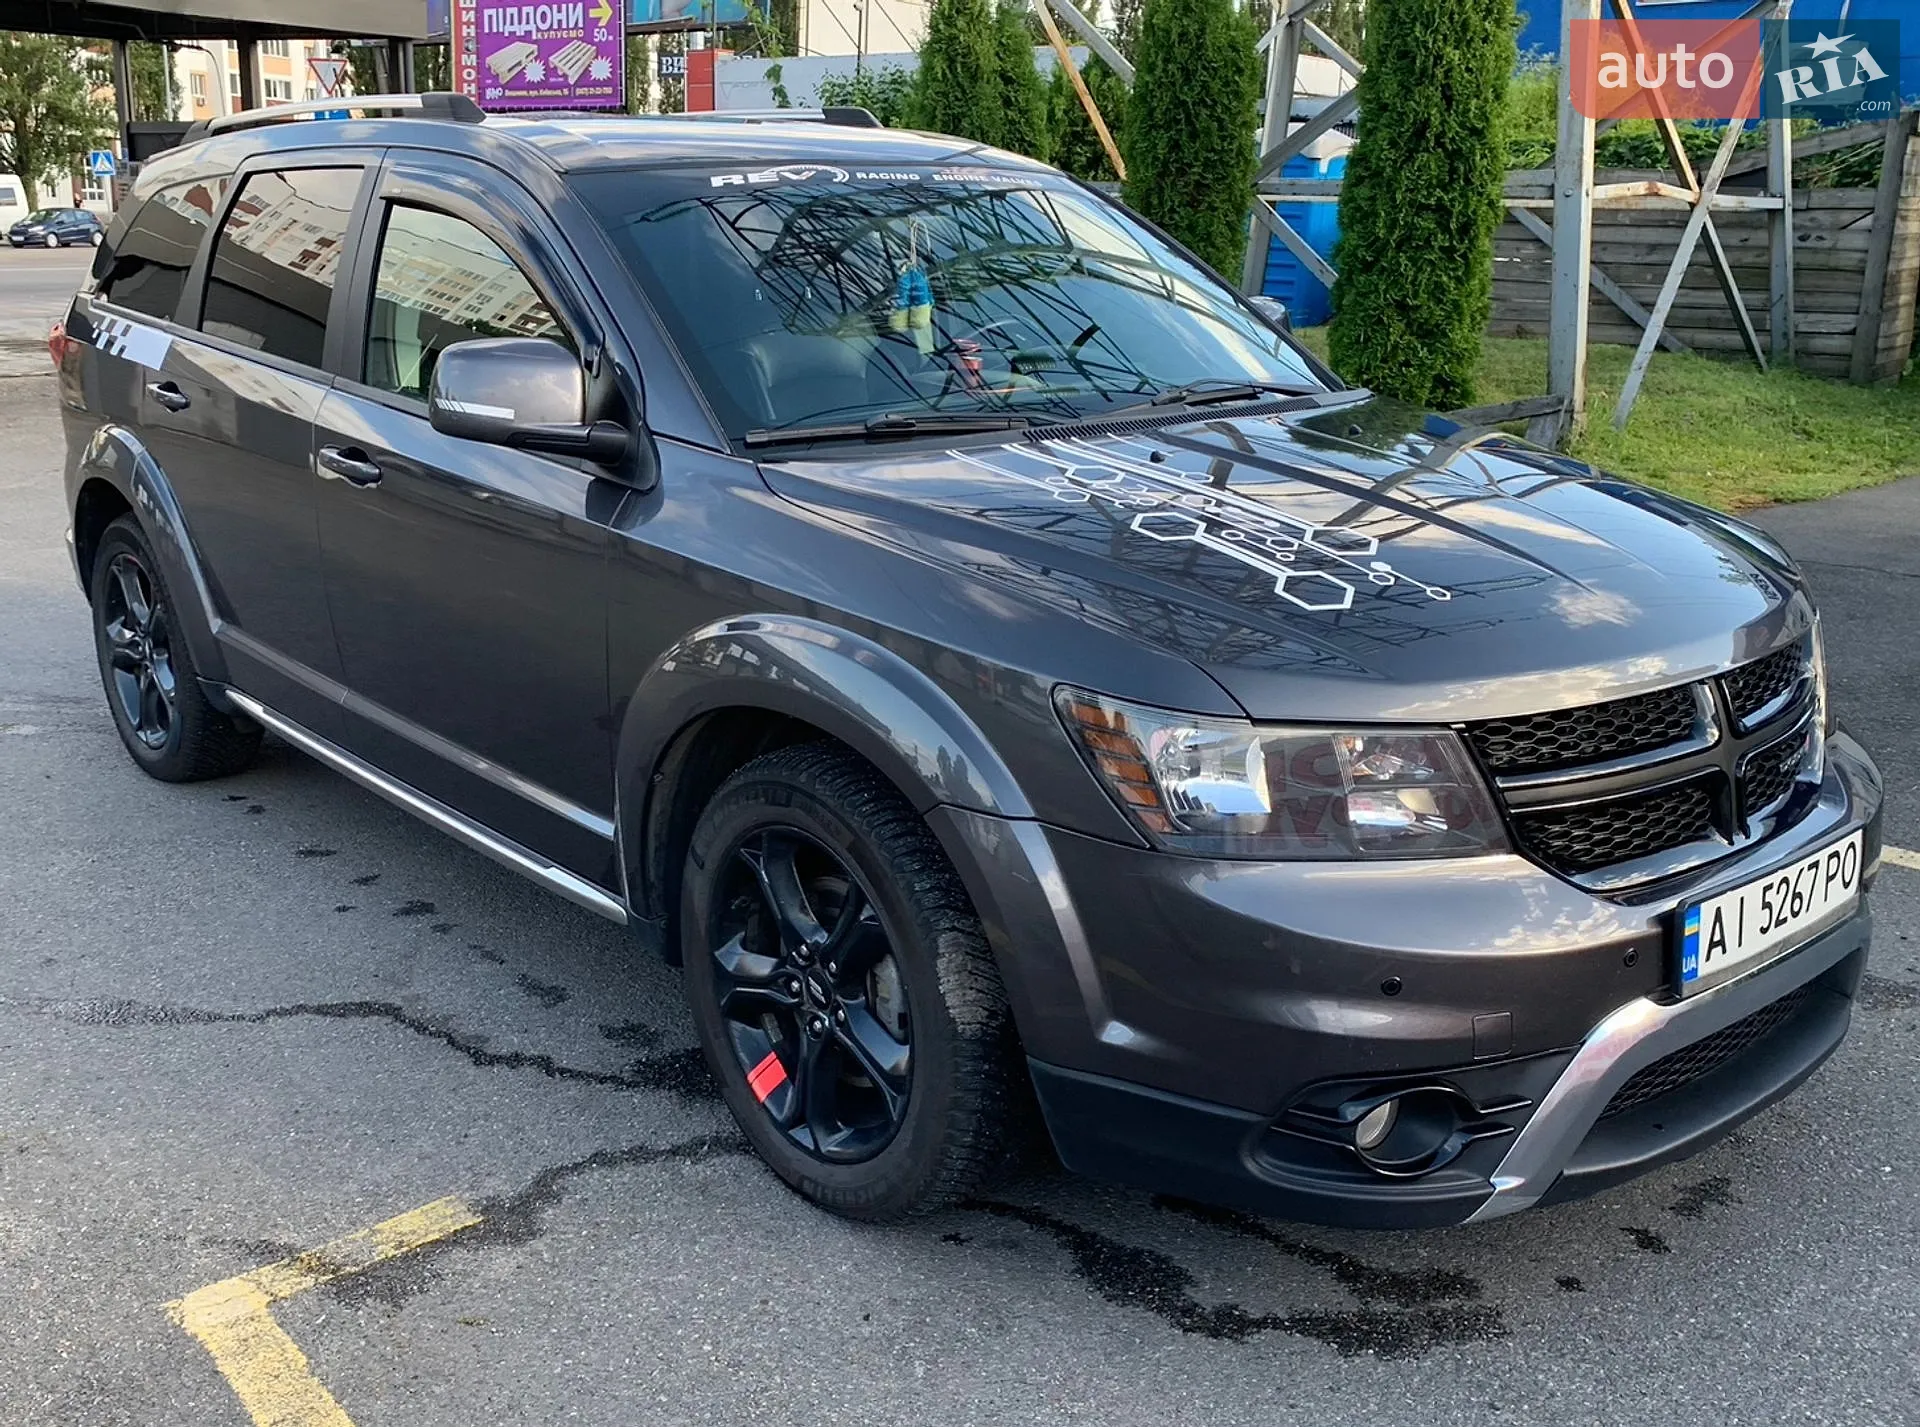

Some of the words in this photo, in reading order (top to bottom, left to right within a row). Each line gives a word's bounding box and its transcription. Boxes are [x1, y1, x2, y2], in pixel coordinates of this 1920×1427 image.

[483, 2, 583, 39] ПІДДОНИ
[710, 170, 816, 187] REV
[856, 171, 921, 181] RACING
[1704, 896, 1744, 962] AI
[1759, 859, 1820, 935] 5267
[1823, 841, 1856, 902] PO
[1682, 956, 1697, 973] UA
